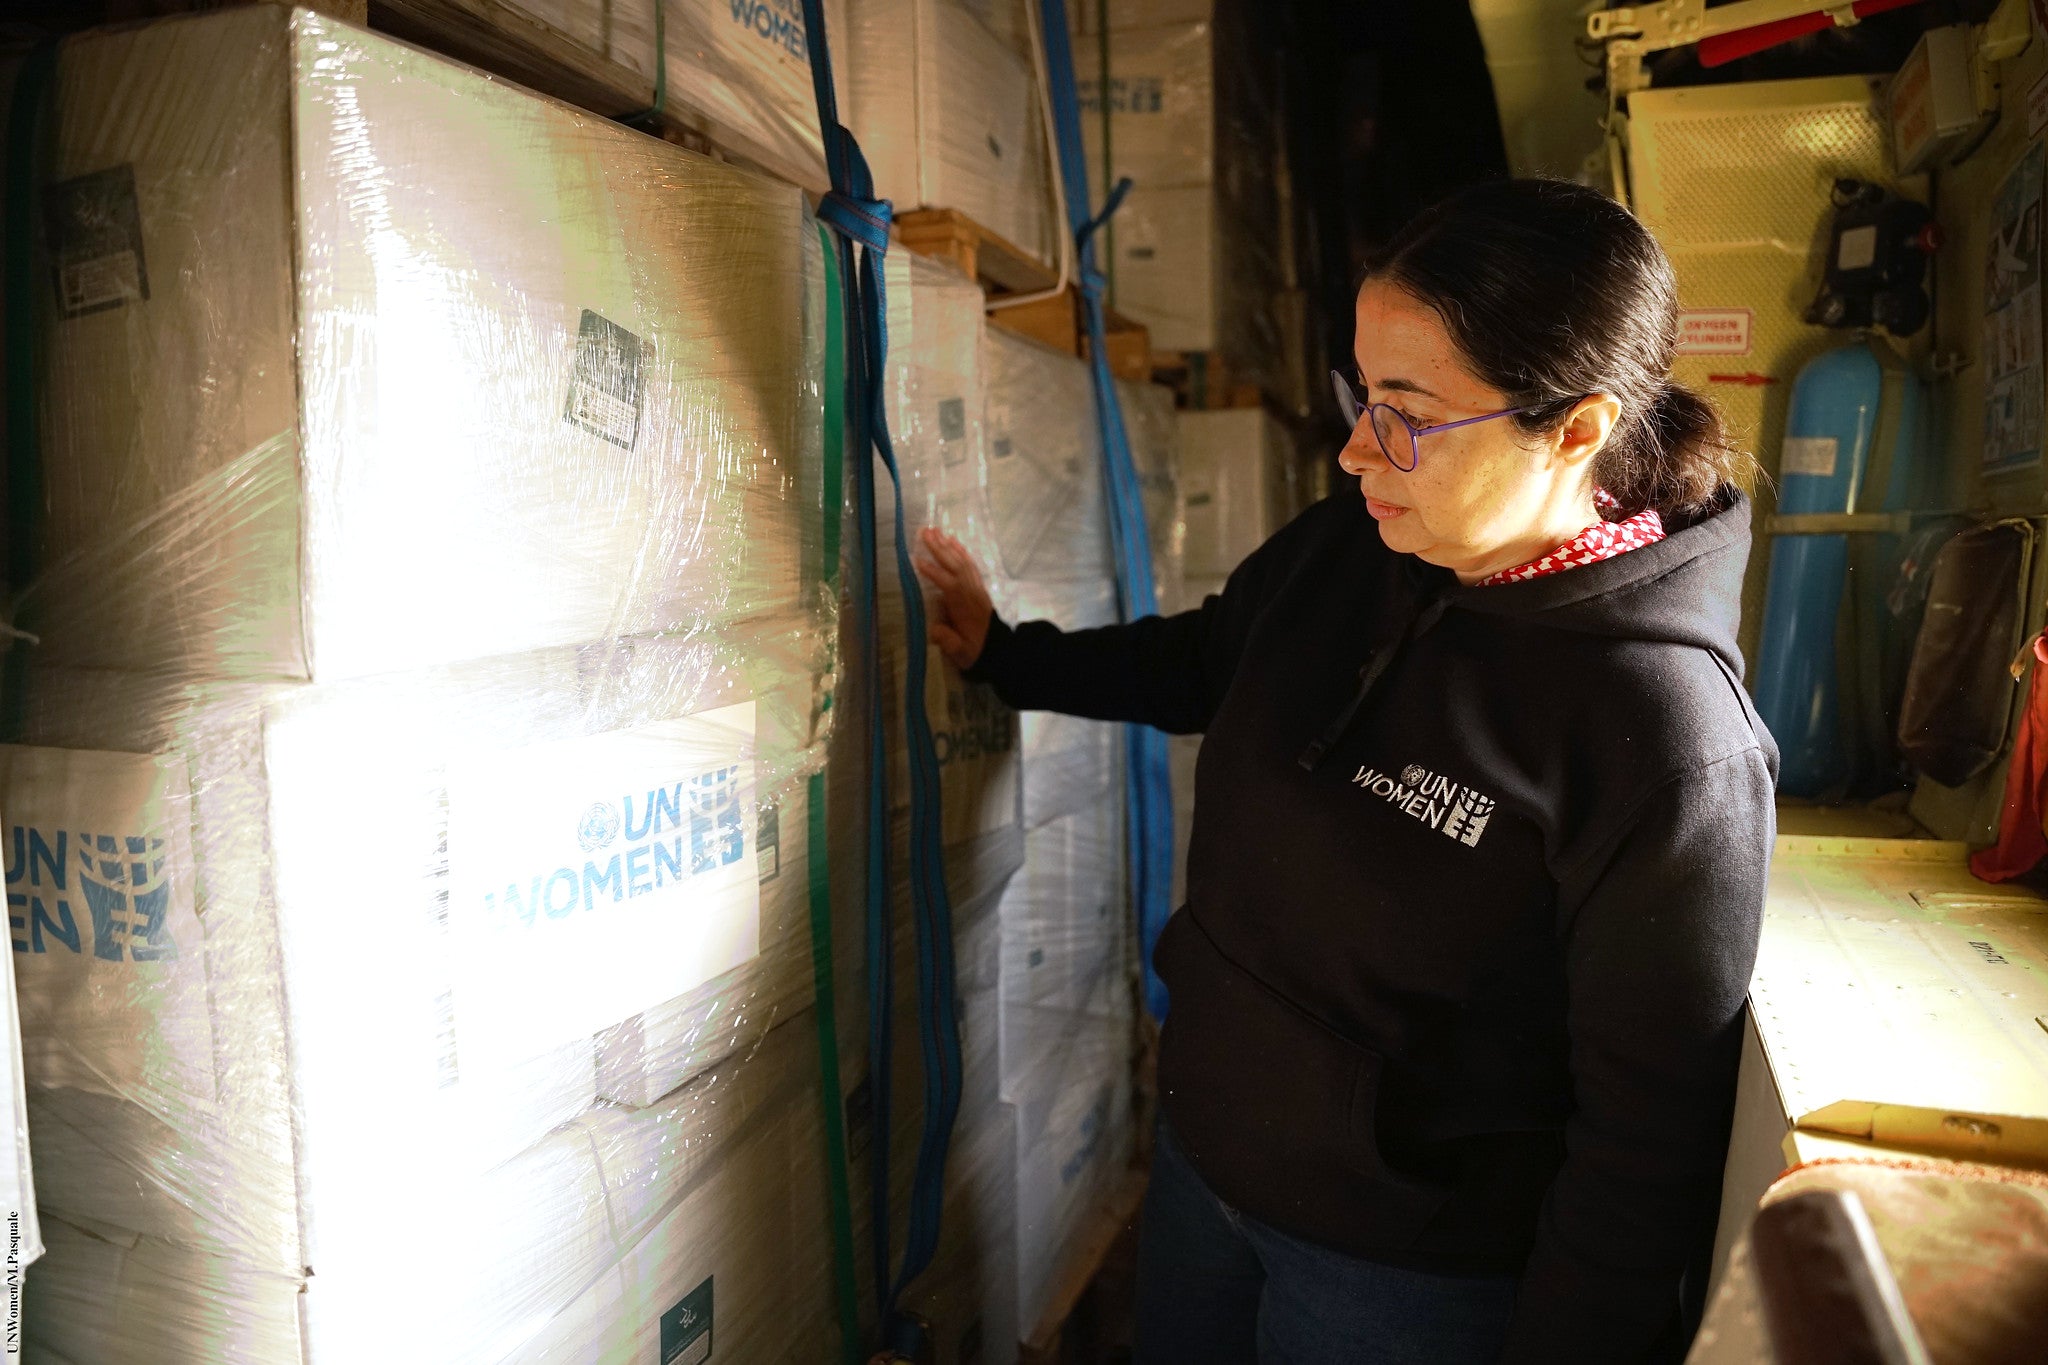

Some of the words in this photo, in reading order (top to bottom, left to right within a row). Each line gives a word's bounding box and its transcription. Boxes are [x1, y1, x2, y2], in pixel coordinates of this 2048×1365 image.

[729, 0, 808, 61] WOME
[1684, 320, 1738, 331] OXYGEN
[623, 781, 683, 842] UN
[1351, 765, 1447, 830] WOMEN
[1420, 771, 1458, 806] UN
[484, 836, 683, 930] WOMEN
